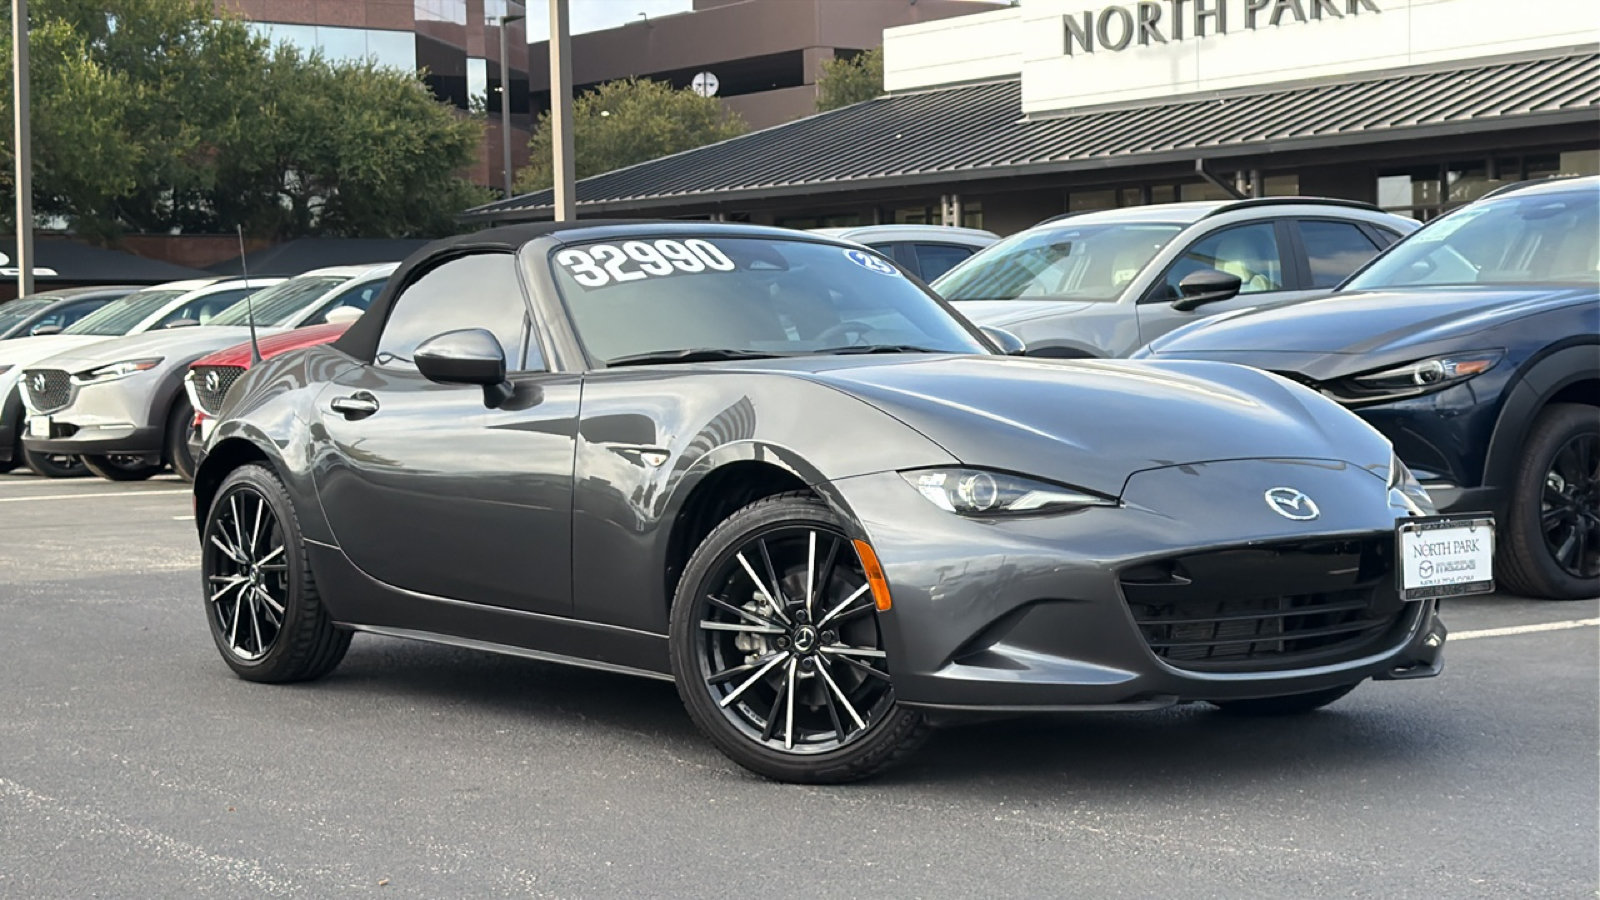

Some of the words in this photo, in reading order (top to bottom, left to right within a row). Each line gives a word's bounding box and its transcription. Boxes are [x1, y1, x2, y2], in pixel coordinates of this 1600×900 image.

[1063, 0, 1227, 56] NORTH
[557, 239, 736, 287] 32990
[855, 252, 892, 273] 25
[1413, 541, 1451, 558] NORTH
[1453, 539, 1480, 554] PARK
